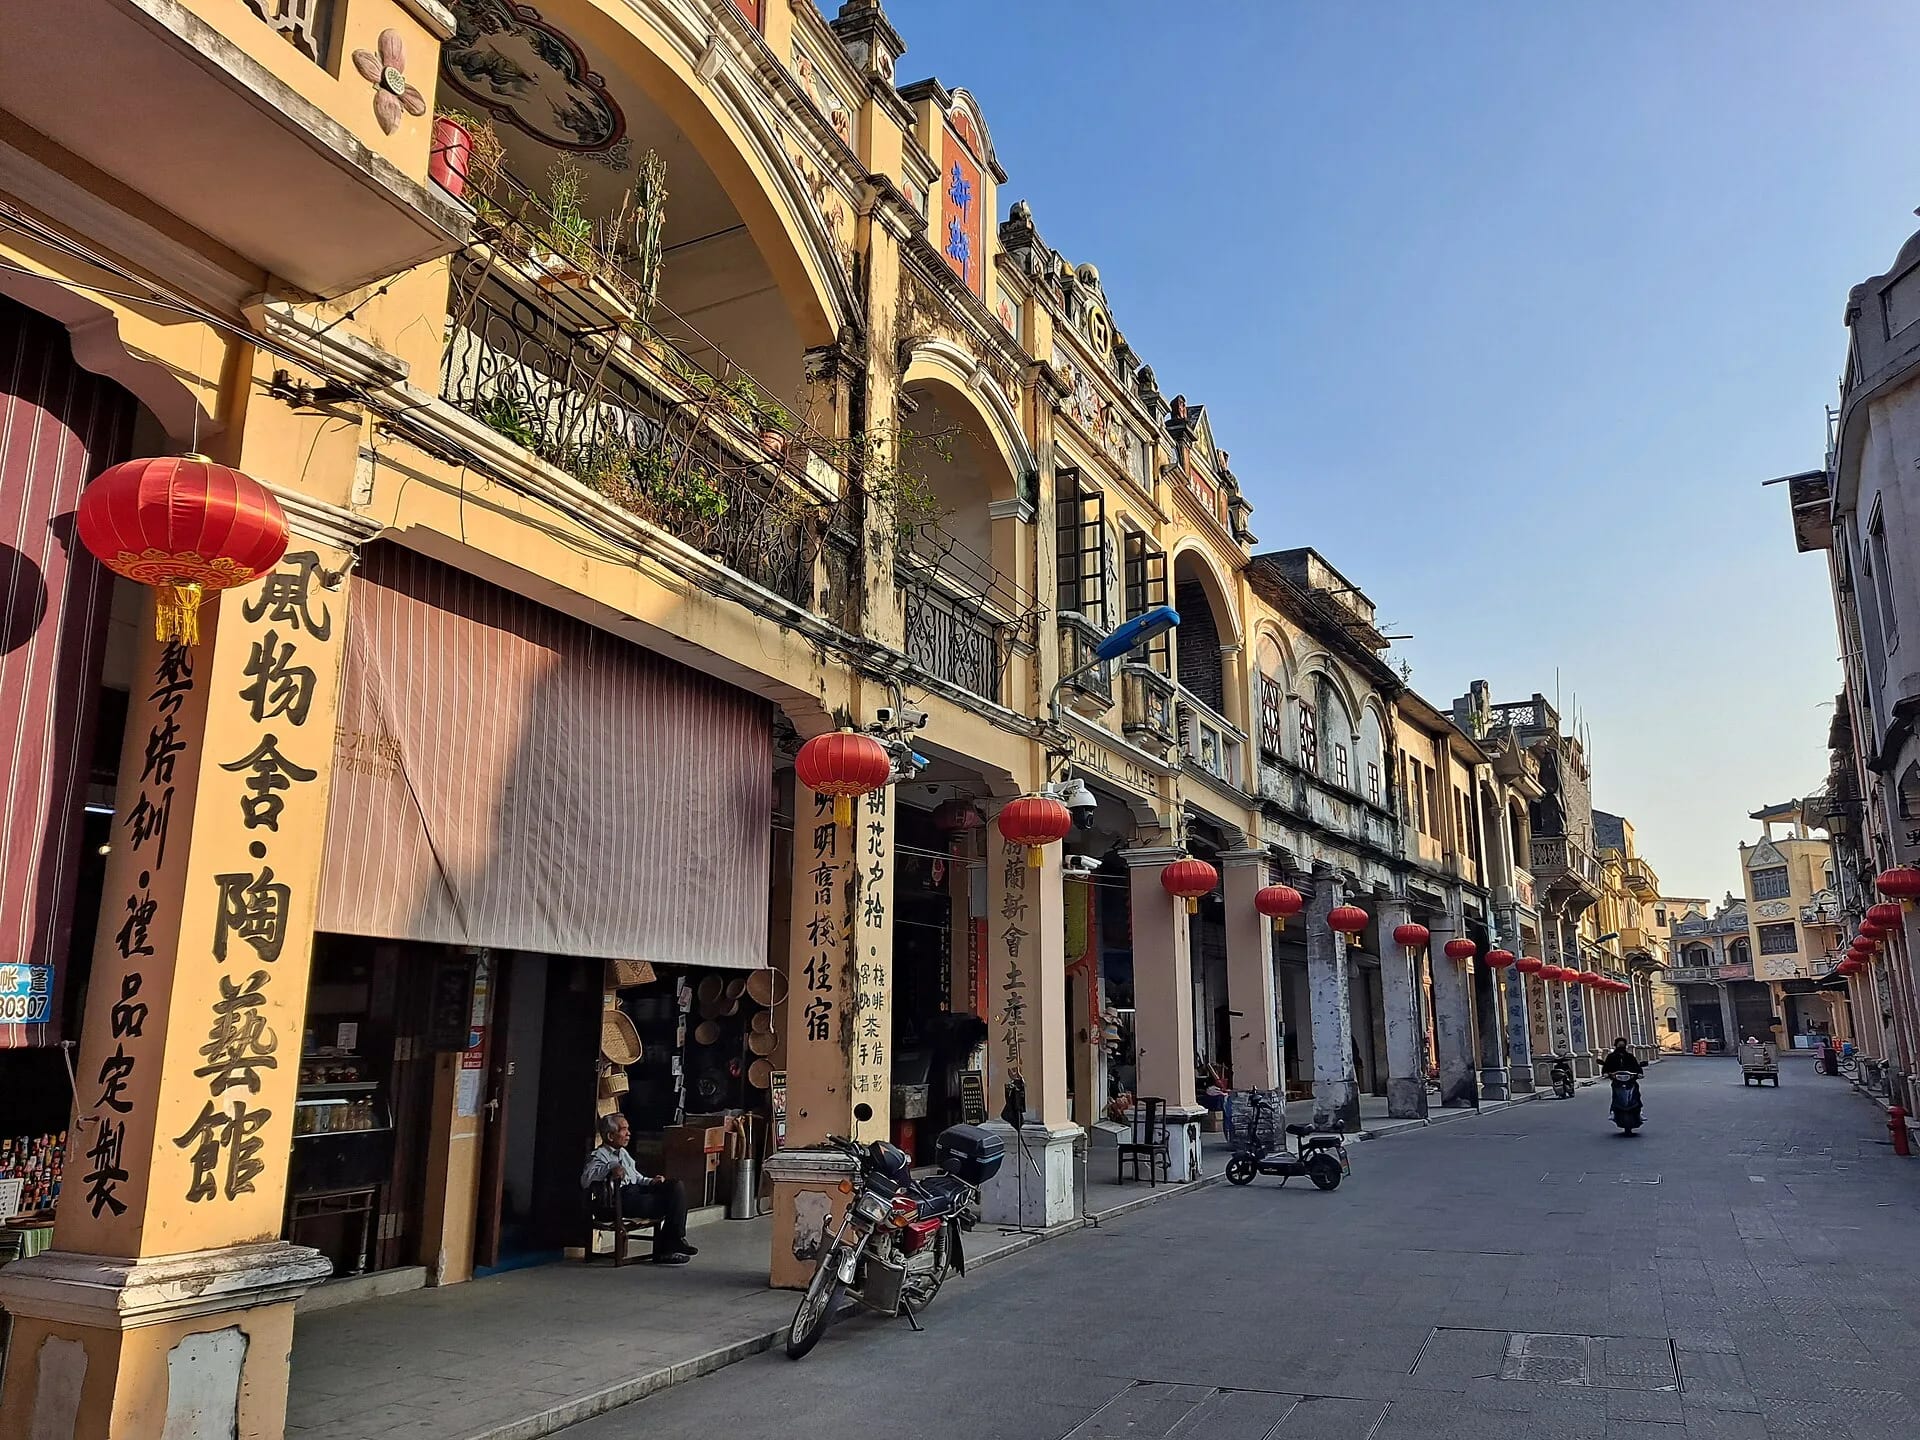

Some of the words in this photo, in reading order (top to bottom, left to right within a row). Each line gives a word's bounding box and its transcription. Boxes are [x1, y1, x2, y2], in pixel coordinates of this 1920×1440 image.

[172, 550, 331, 1204] 風物舍·陶藝館
[859, 1041, 883, 1066] 手信
